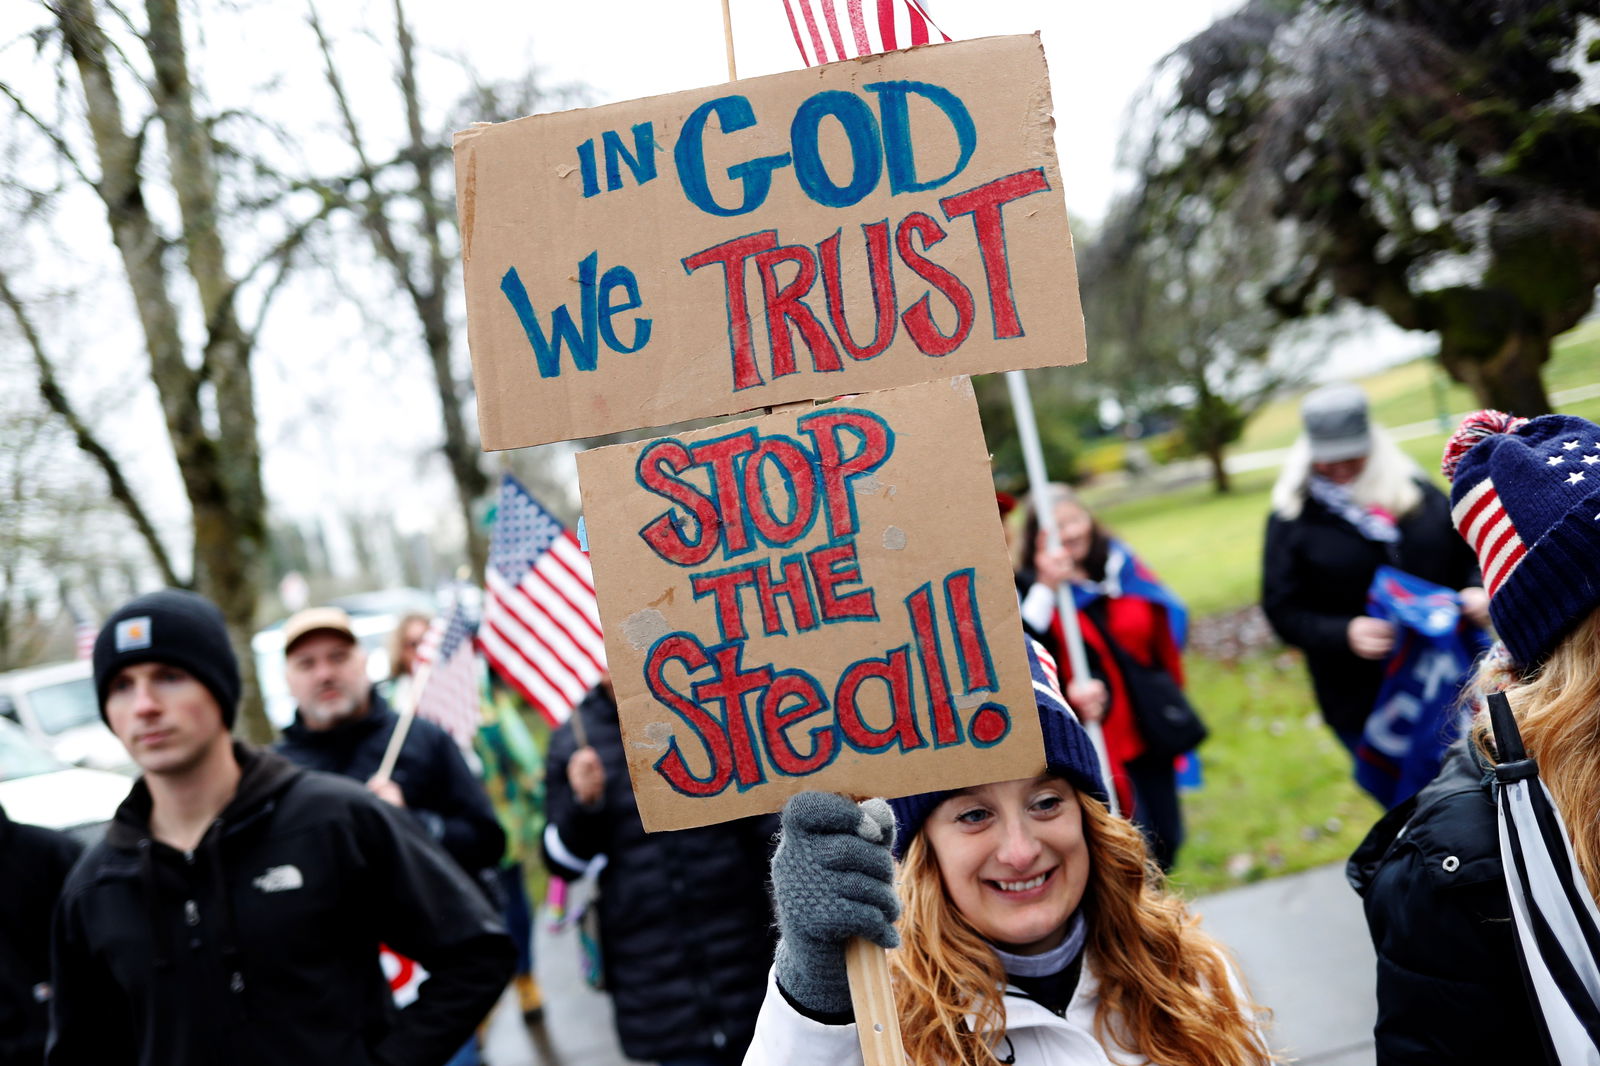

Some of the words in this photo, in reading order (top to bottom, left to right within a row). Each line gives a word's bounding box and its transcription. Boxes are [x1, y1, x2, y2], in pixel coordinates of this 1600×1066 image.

[576, 121, 657, 198] IN
[674, 80, 977, 217] GOD
[500, 250, 652, 378] We
[681, 167, 1052, 392] TRUST
[635, 407, 895, 567] STOP
[689, 538, 880, 642] THE
